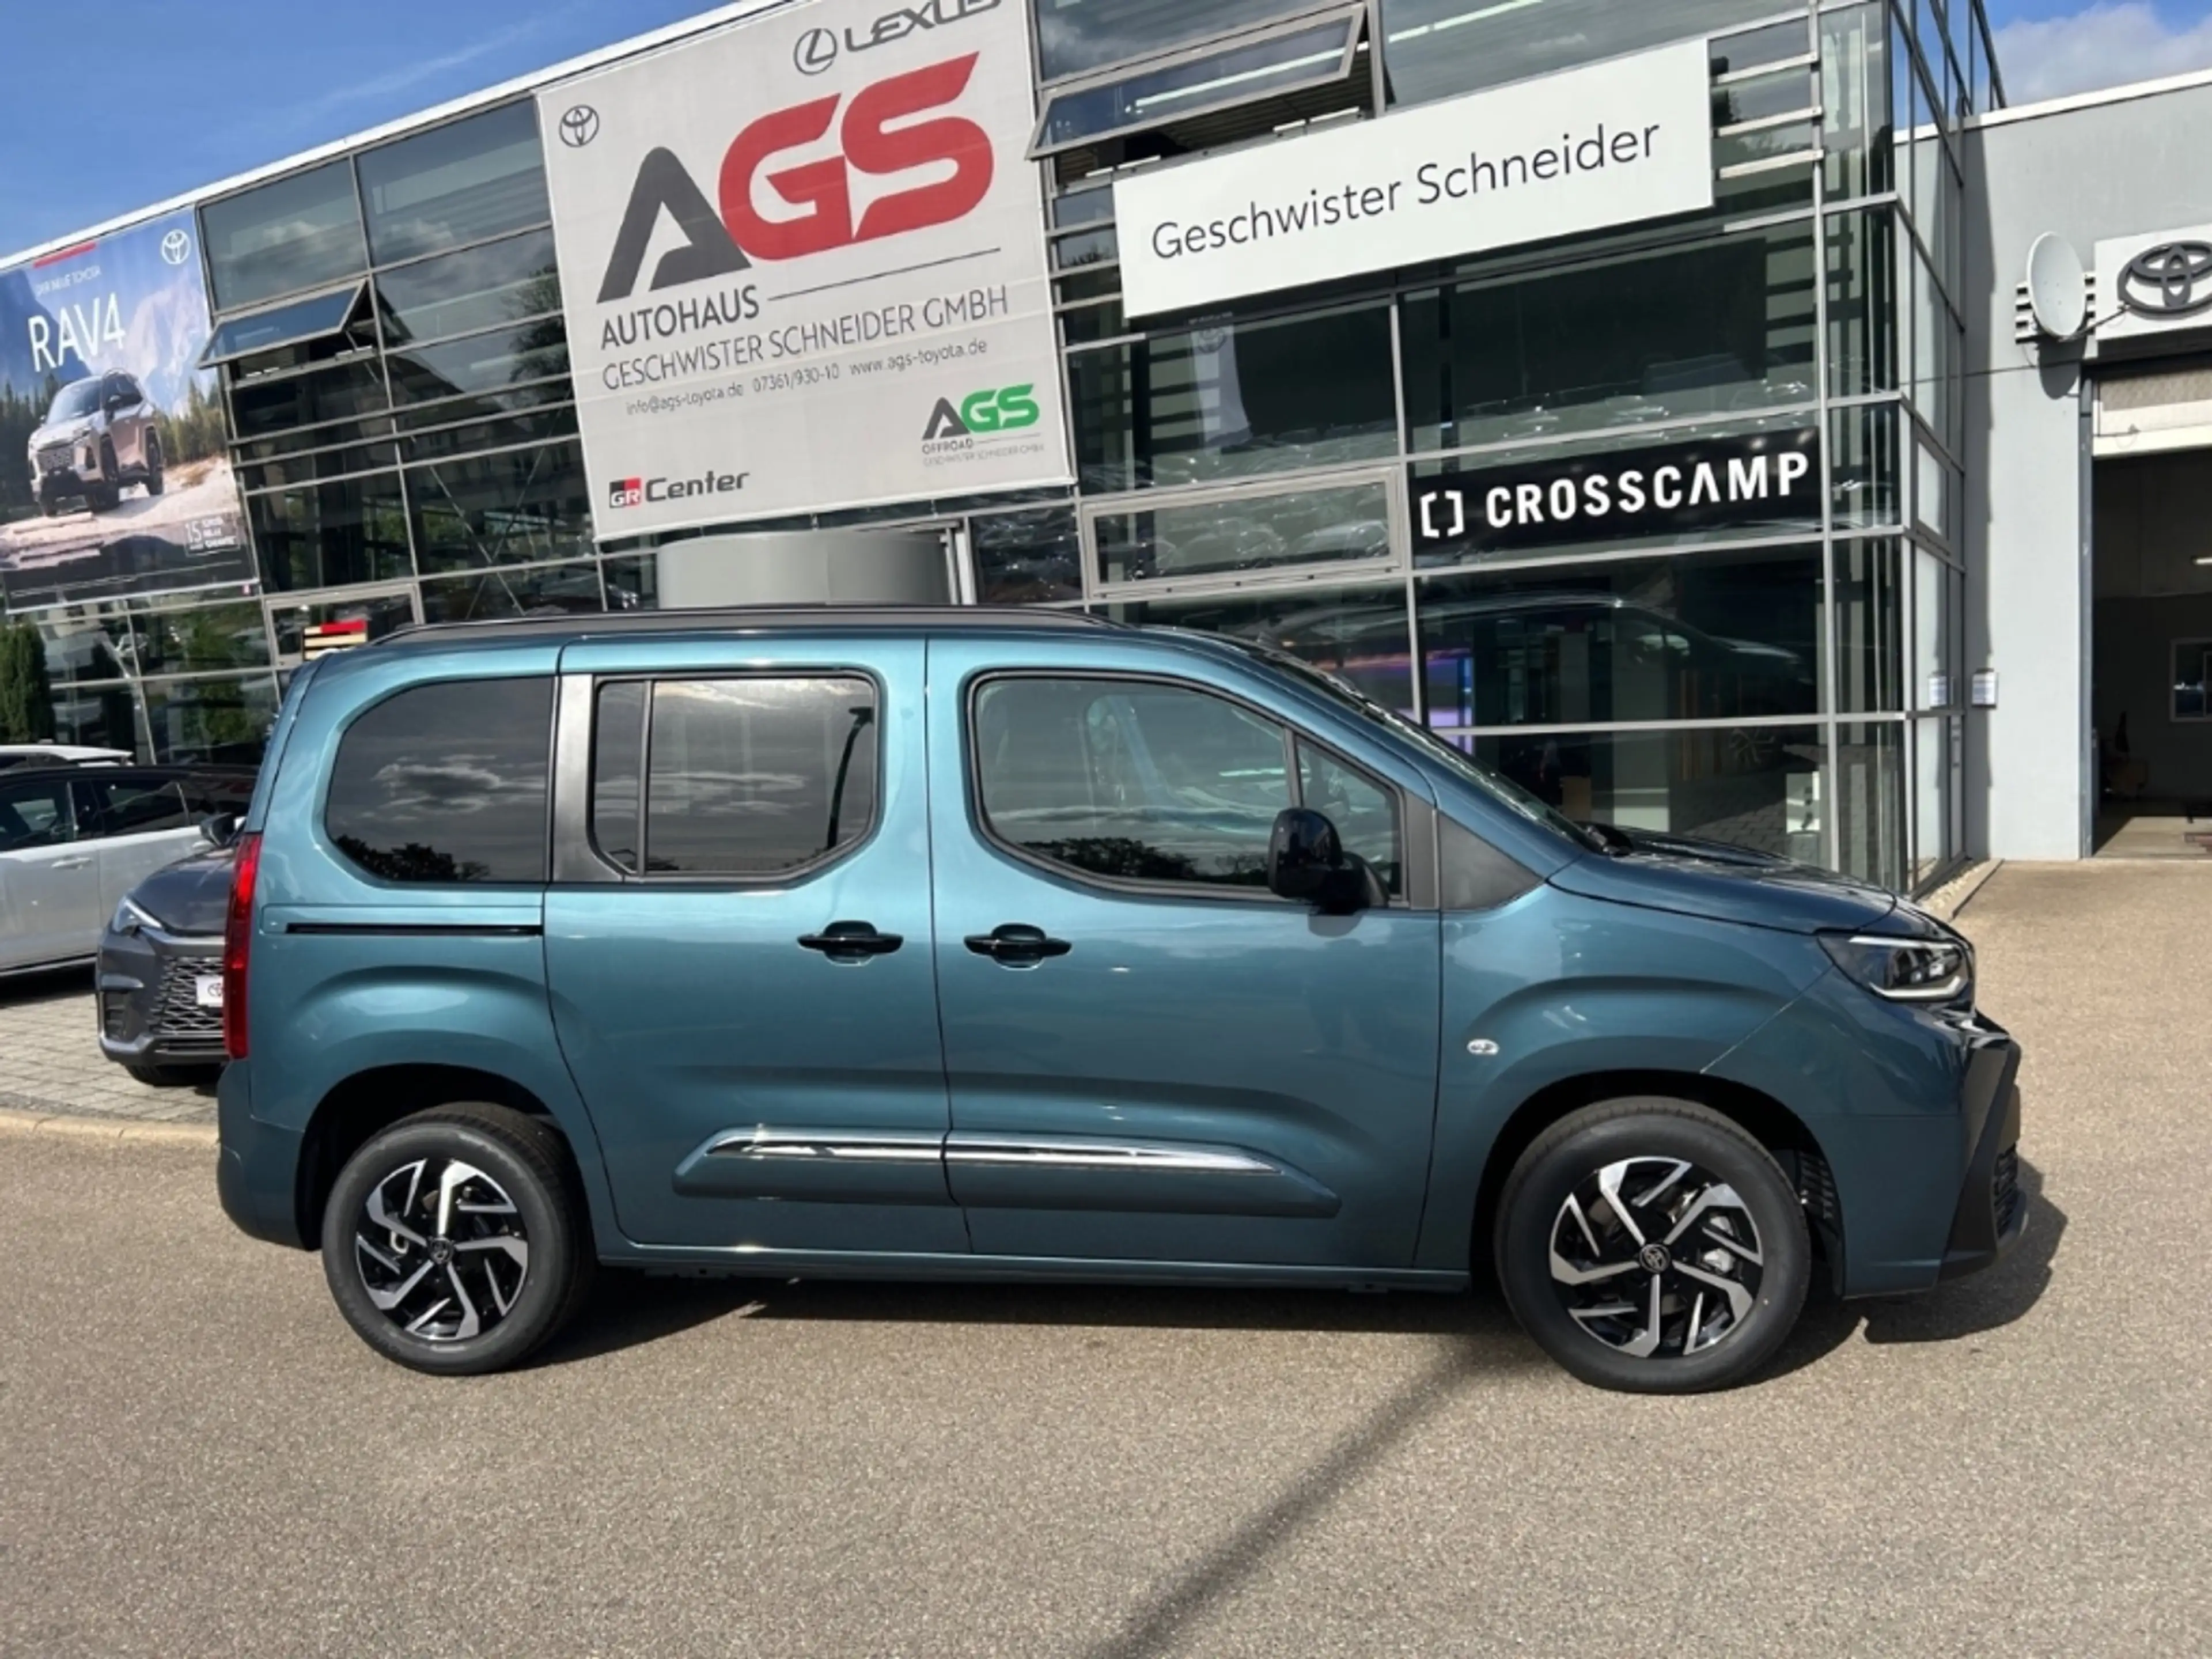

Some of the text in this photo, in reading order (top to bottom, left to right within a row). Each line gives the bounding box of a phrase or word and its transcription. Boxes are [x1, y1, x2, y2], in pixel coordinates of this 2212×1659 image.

[597, 51, 994, 304] AGS
[1152, 123, 1660, 259] Geschwister Schneider
[28, 291, 127, 372] RAV4
[601, 284, 760, 350] AUTOHAUS
[602, 285, 1008, 390] GESCHWISTER SCHNEIDER GMBH
[626, 337, 987, 415] info@ags-toyota.de 07361/930-10 www.ags-toyota.de
[922, 382, 1040, 441] AGS
[611, 470, 750, 507] GR Center
[1485, 451, 1809, 528] CROSSCAMP
